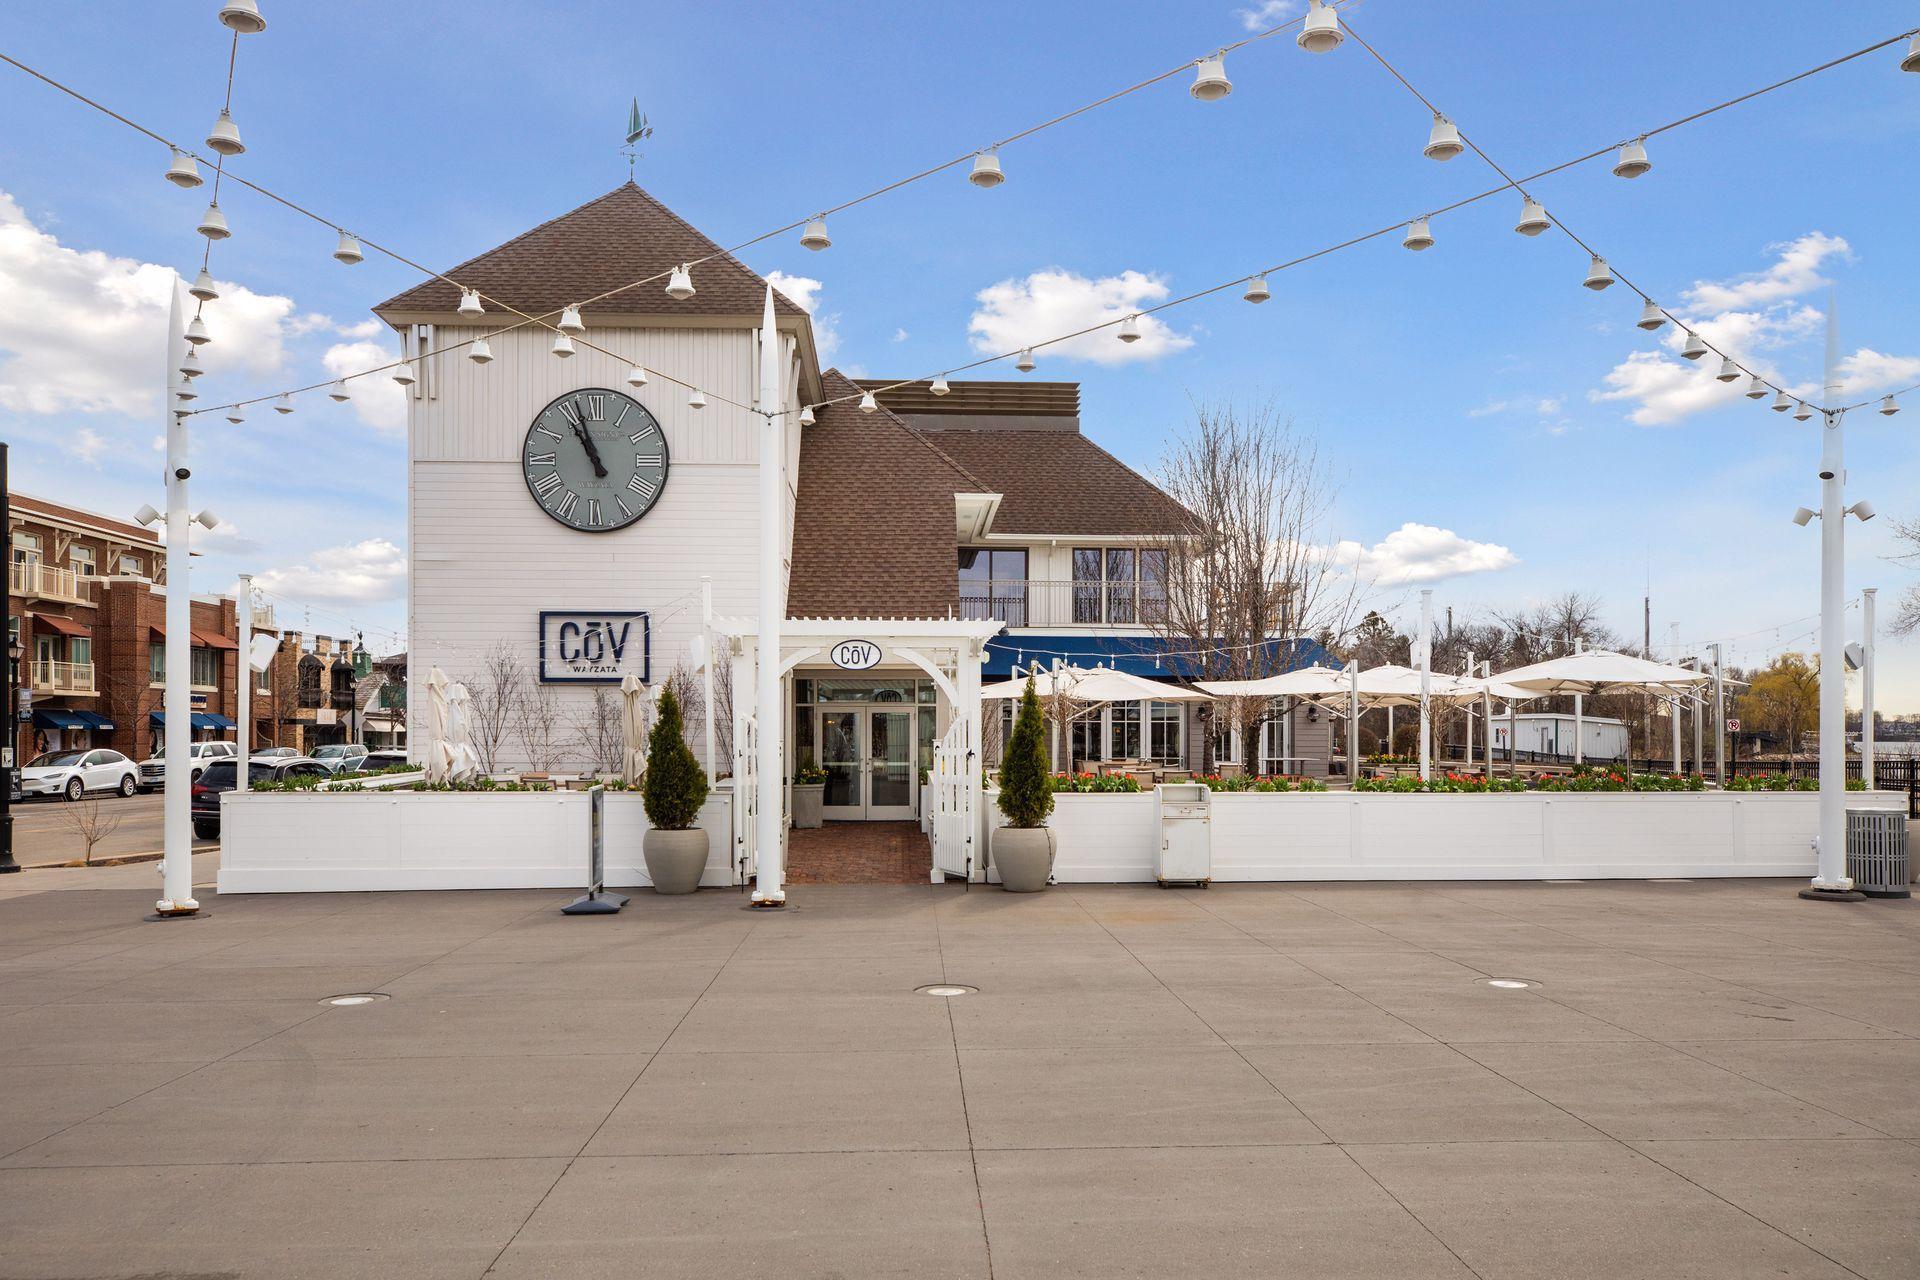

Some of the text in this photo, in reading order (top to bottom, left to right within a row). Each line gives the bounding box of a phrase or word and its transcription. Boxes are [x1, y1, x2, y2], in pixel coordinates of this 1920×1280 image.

[587, 395, 605, 421] XII
[613, 403, 632, 428] I
[536, 423, 563, 444] X
[629, 425, 656, 445] II
[529, 452, 556, 466] IX
[636, 453, 662, 468] III
[534, 470, 564, 501] VIII
[626, 473, 657, 500] IIII
[555, 490, 580, 520] VII
[588, 499, 603, 526] VI
[615, 494, 633, 518] V
